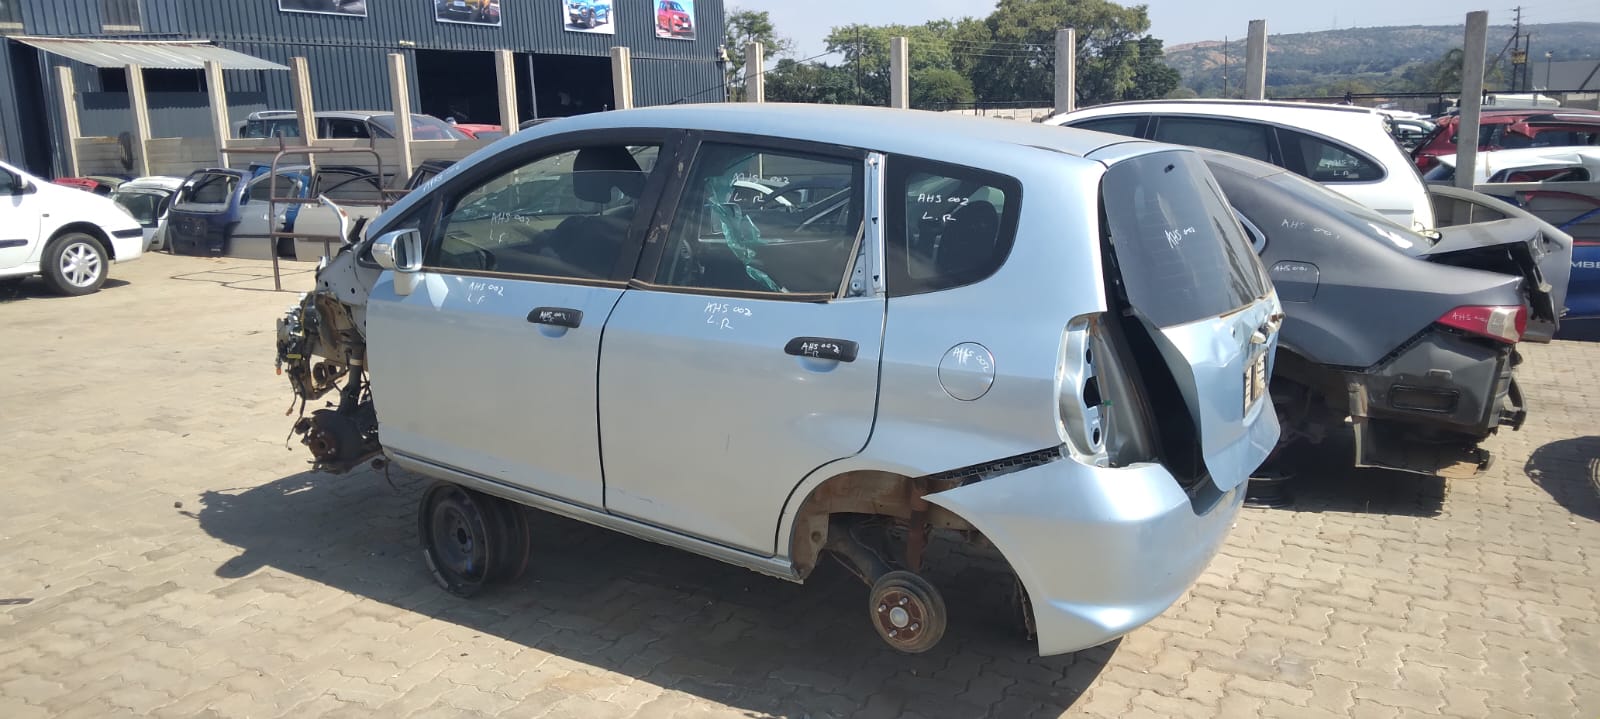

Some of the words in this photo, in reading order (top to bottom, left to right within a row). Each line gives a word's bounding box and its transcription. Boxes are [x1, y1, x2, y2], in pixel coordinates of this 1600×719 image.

[917, 193, 942, 203] AHS
[947, 197, 969, 206] 002
[491, 212, 511, 225] AHS
[1281, 218, 1304, 229] AHS
[1164, 229, 1182, 249] AHS
[469, 281, 486, 291] AHS
[488, 284, 504, 297] 002
[704, 301, 730, 313] AHS
[732, 306, 753, 316] 002
[801, 341, 819, 351] AHS
[820, 343, 840, 354] 002
